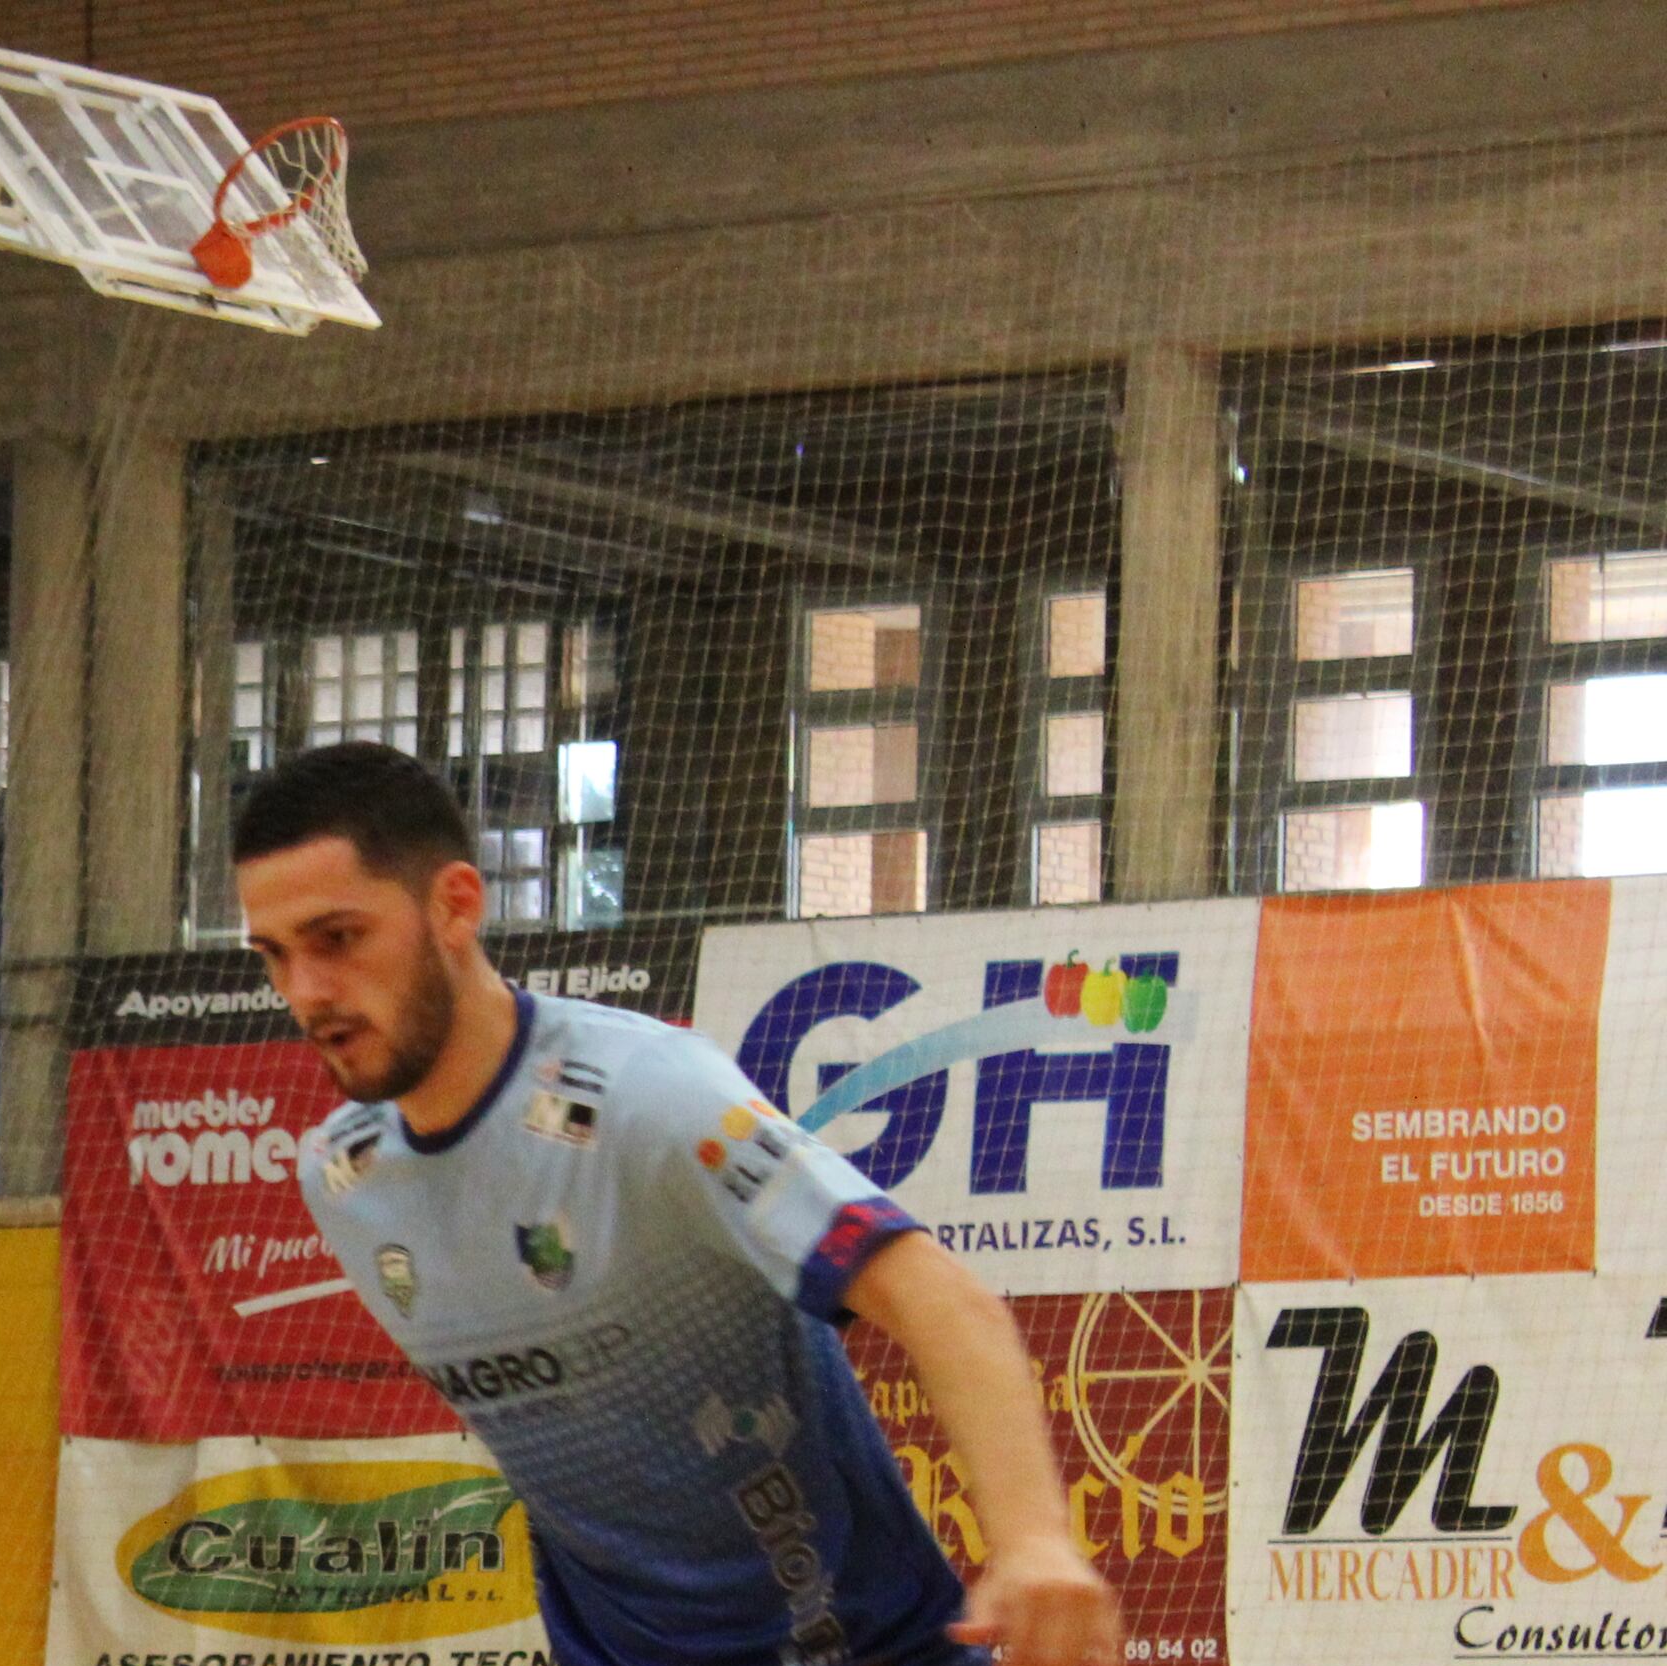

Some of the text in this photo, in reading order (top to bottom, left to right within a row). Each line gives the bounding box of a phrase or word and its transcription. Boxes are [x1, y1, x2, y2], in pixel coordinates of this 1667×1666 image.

[527, 963, 651, 999] El Ejido
[117, 985, 289, 1019] Apoyando
[1351, 1103, 1567, 1143] SEMBRANDO
[127, 1127, 313, 1187] rome
[1381, 1147, 1566, 1184] EL FUTURO
[1419, 1190, 1564, 1218] DESDE 1856
[937, 1215, 1187, 1252] RTALIZAS, S.L.
[889, 1434, 1208, 1566] Rcío
[167, 1517, 507, 1578] Cualin
[1266, 1546, 1517, 1603] MERCADER
[1125, 1637, 1218, 1660] 69 54 02
